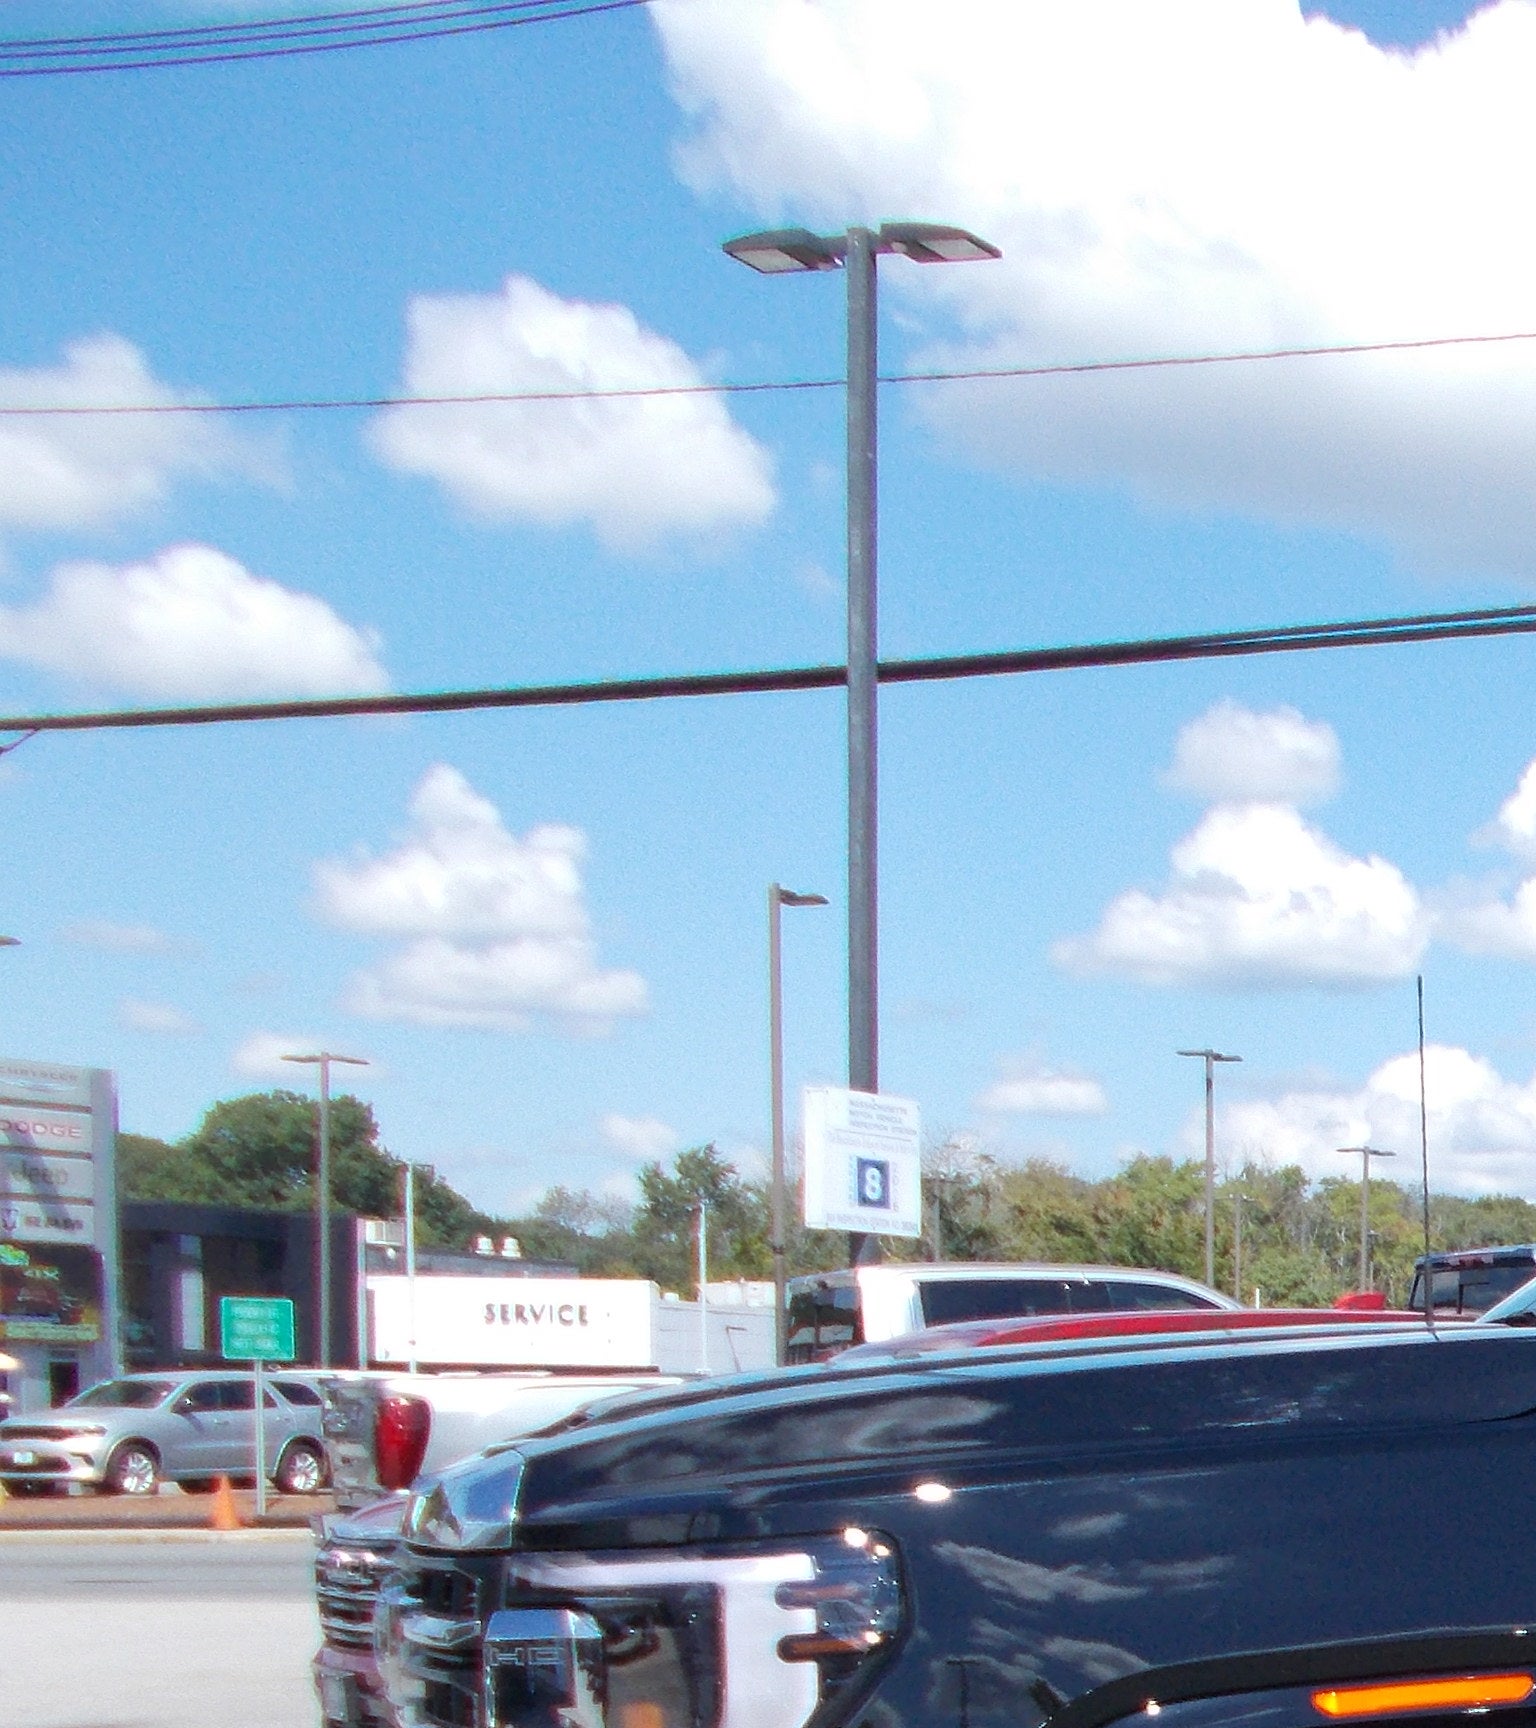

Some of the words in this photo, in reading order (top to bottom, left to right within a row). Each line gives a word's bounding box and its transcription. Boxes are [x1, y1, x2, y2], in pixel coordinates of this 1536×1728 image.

[0, 1118, 83, 1139] DODGE
[865, 1167, 882, 1201] 8
[484, 1302, 589, 1327] SERVICE
